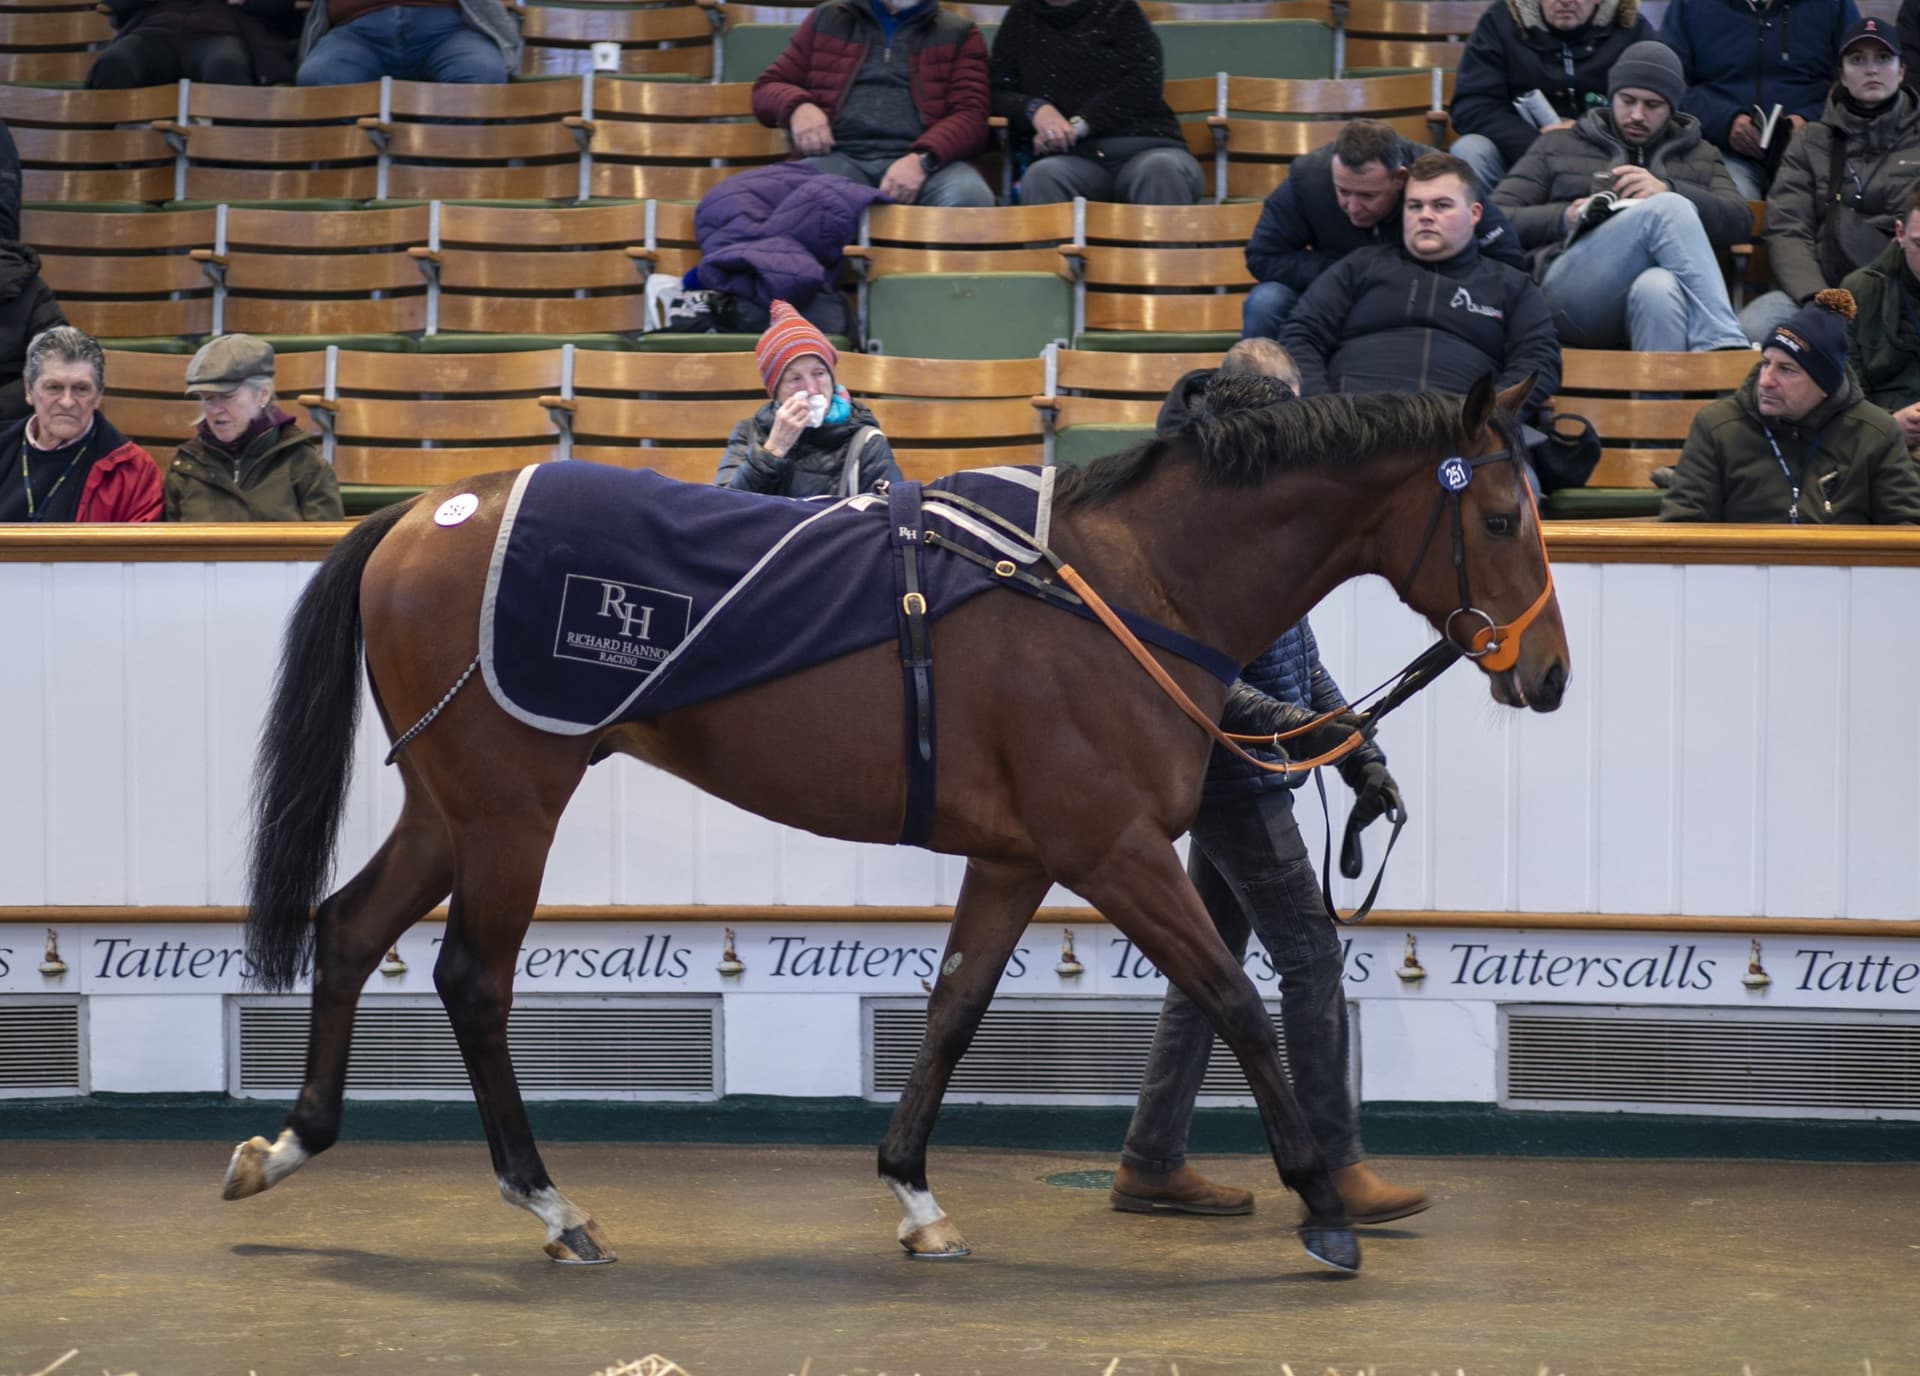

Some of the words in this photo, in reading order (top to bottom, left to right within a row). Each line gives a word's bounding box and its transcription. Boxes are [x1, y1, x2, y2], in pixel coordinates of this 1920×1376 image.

[1445, 463, 1466, 485] 251
[597, 583, 654, 640] RH
[566, 632, 621, 651] RICHARD
[599, 652, 637, 667] RACING
[1450, 943, 1717, 991] Tattersalls
